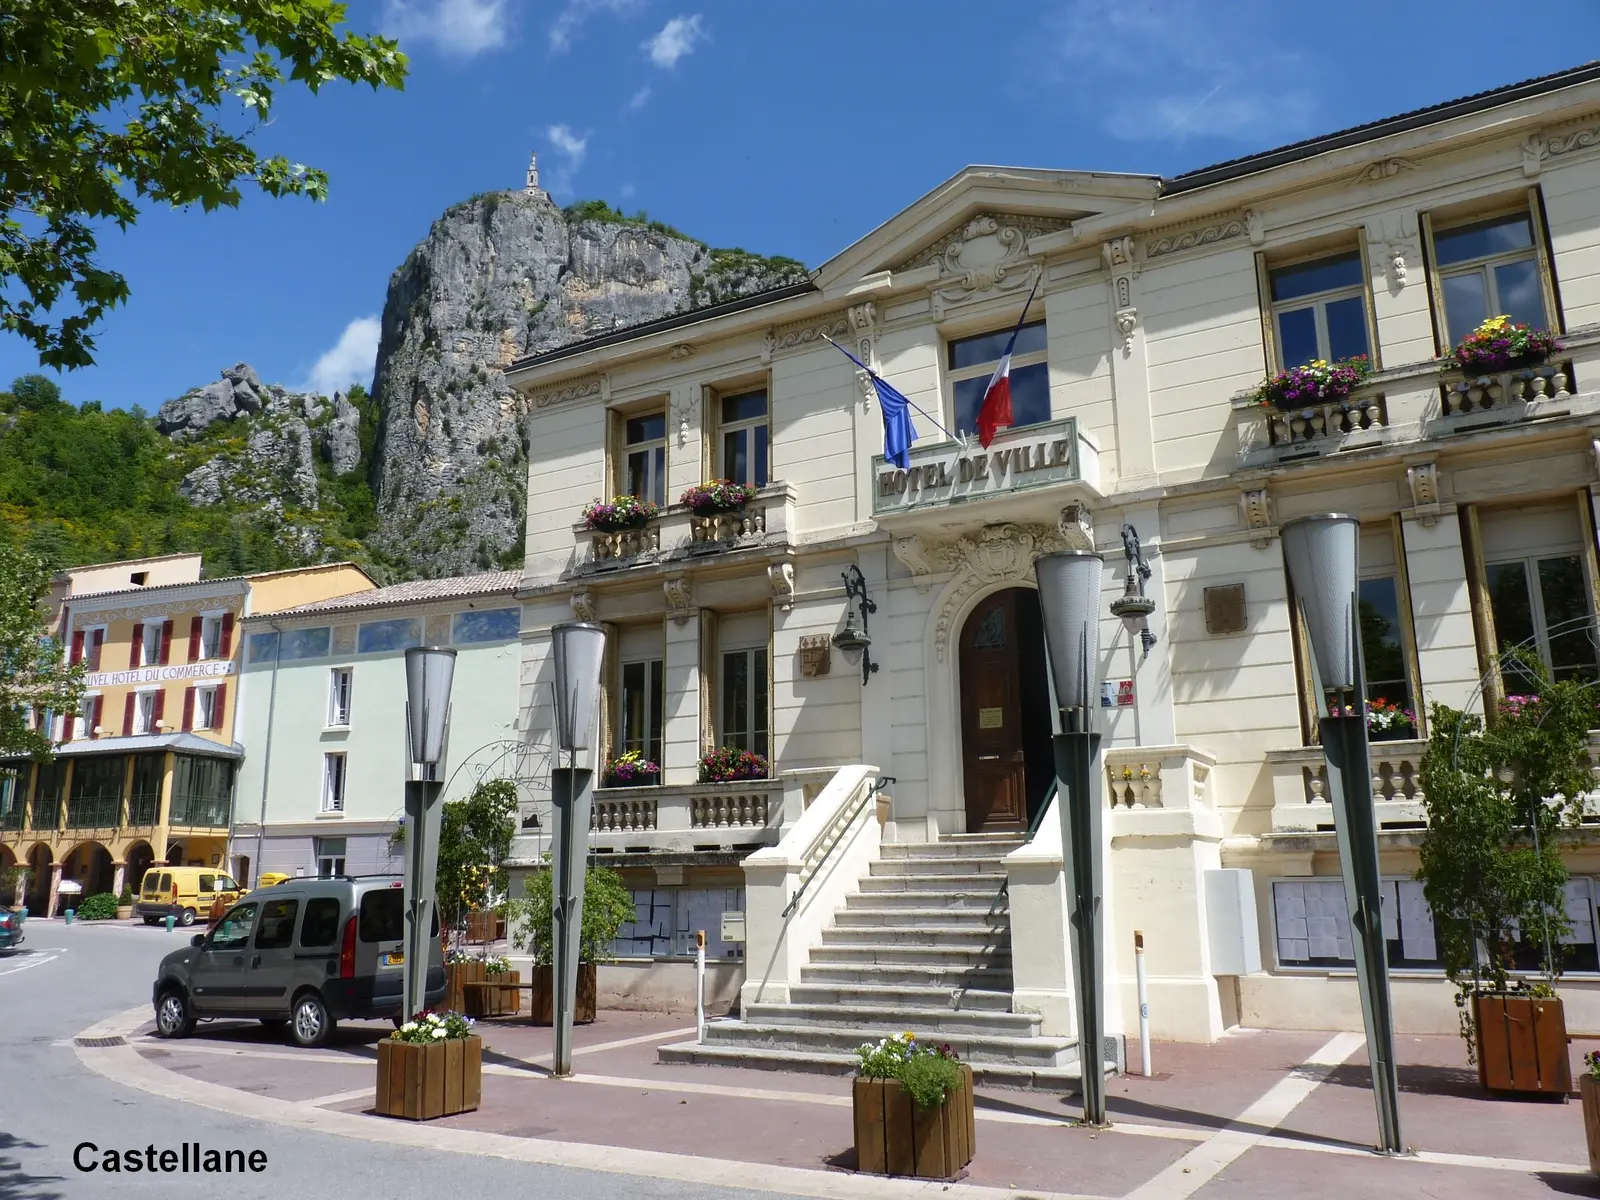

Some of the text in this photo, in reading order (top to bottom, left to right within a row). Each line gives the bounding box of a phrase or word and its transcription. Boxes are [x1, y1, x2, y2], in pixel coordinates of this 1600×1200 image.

[879, 439, 1071, 497] HOTEL DE VILLE
[81, 663, 221, 686] OUVEL HOTEL DU COMMERCE
